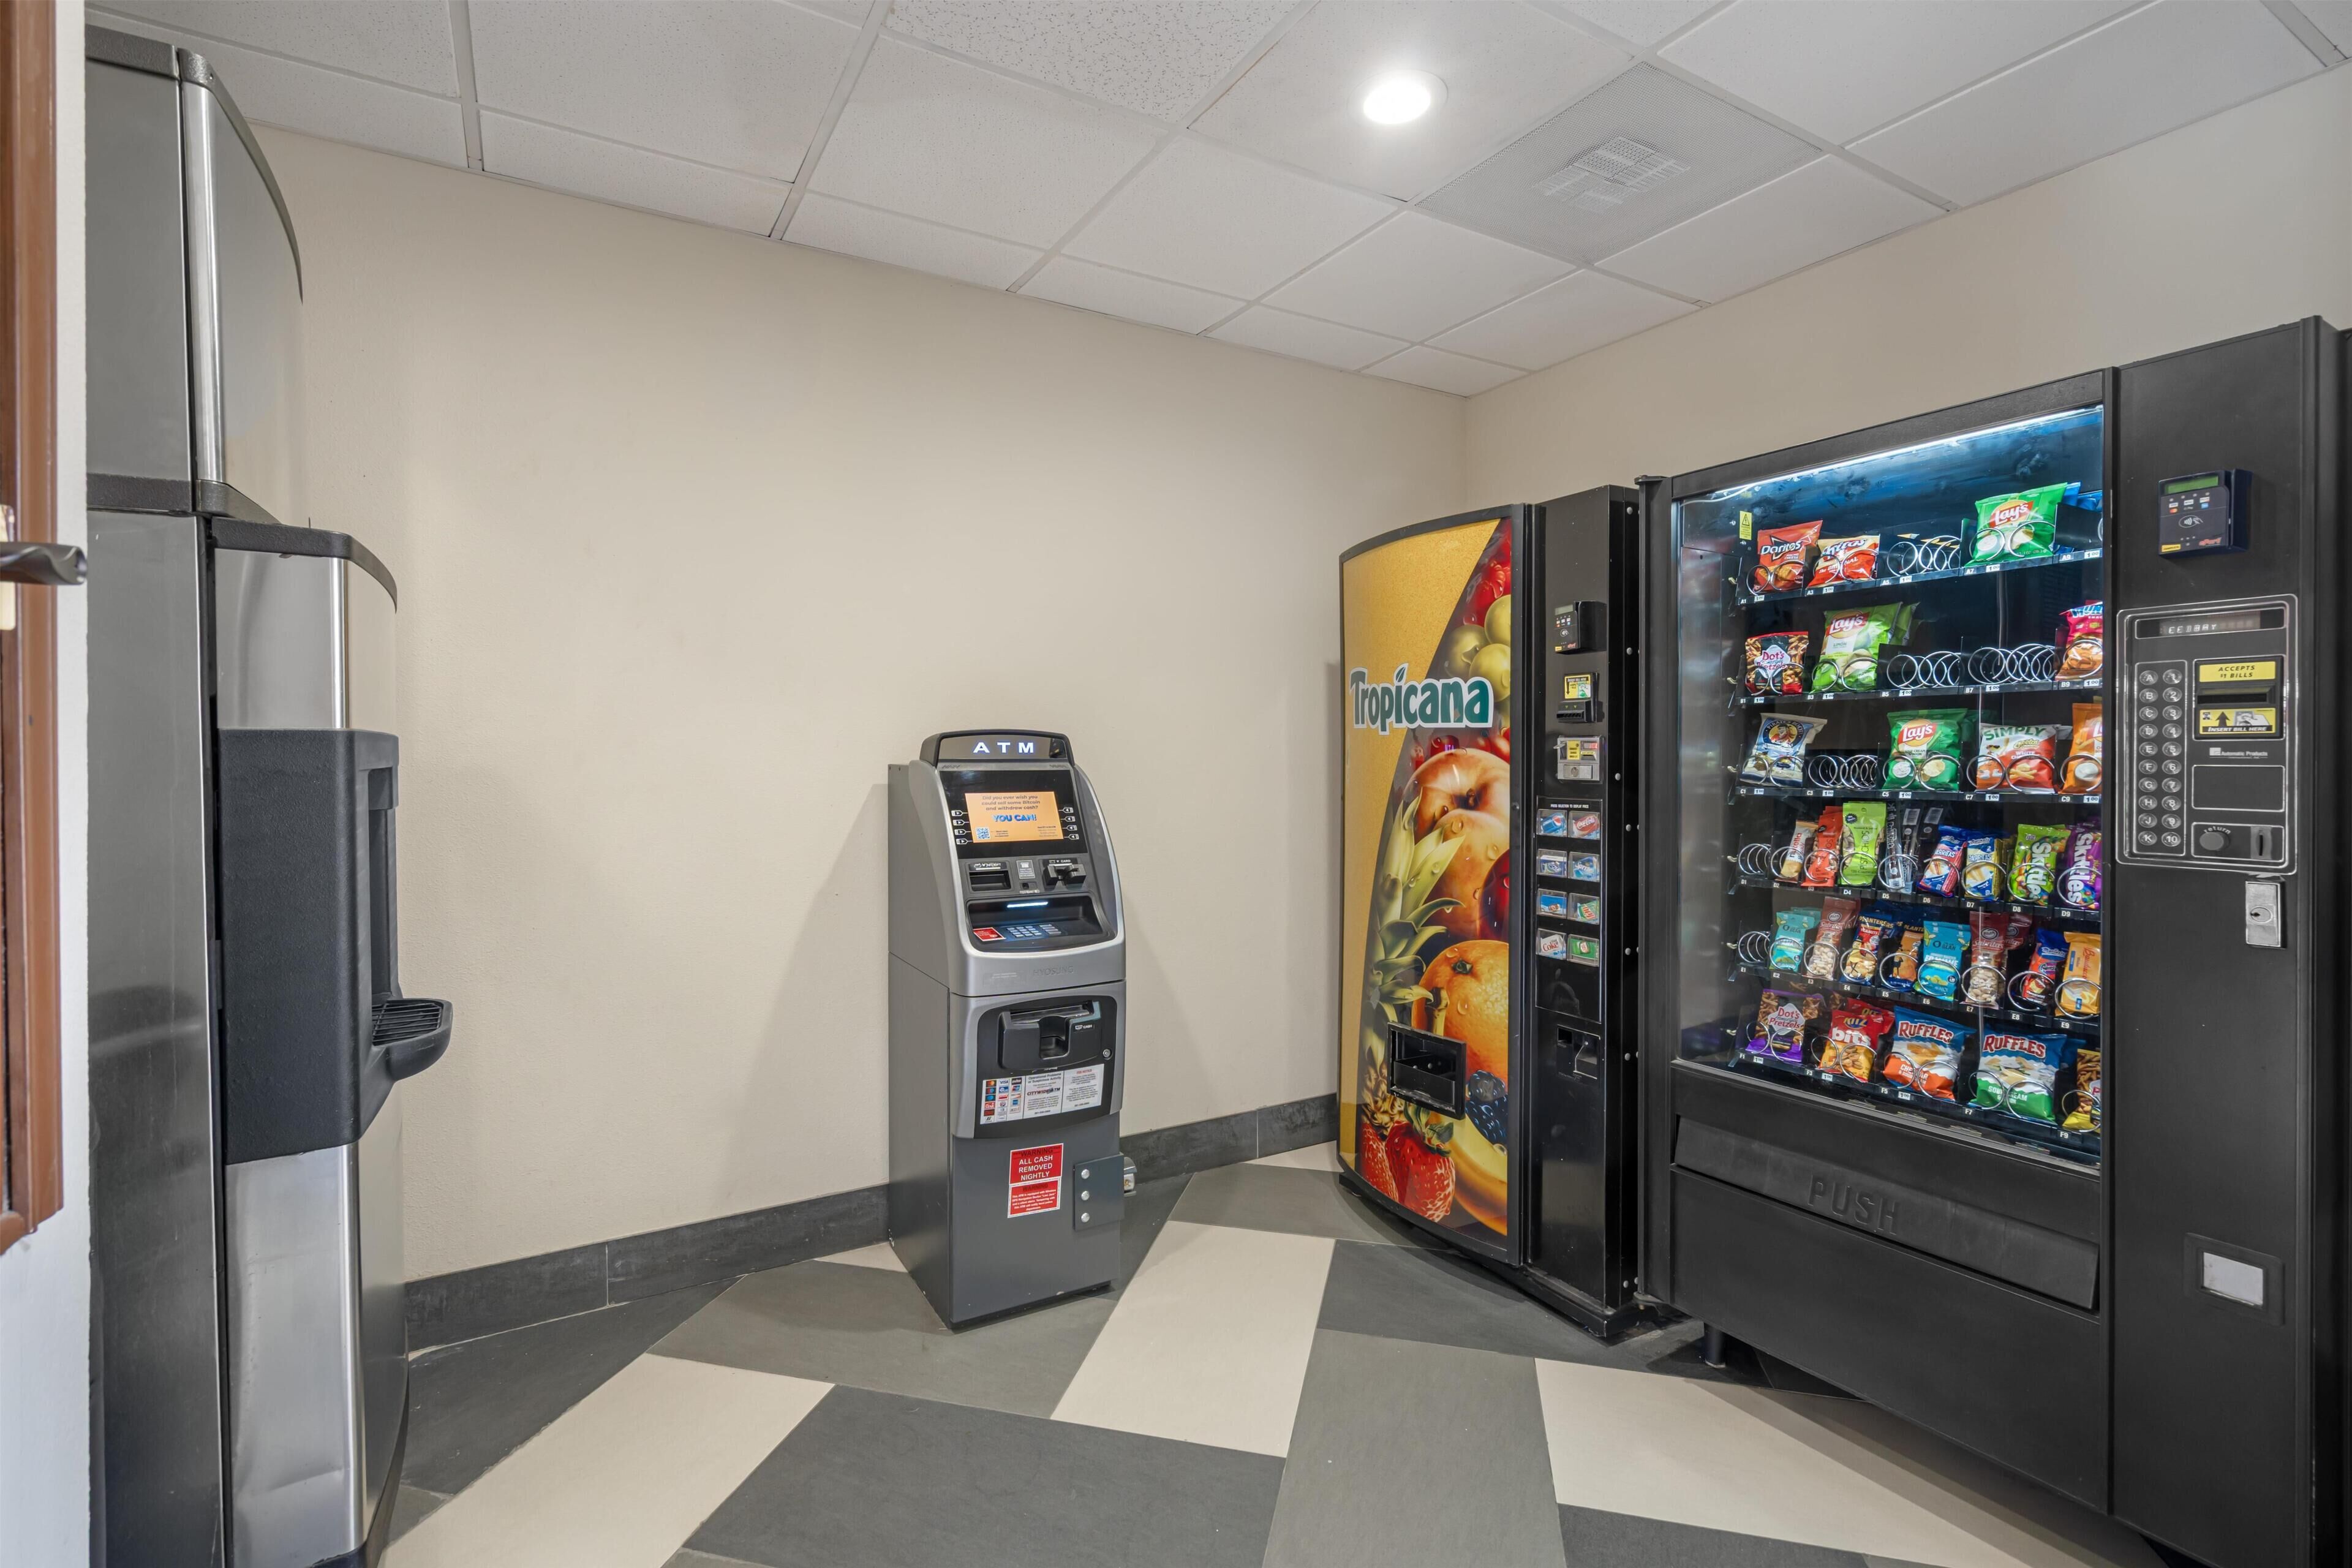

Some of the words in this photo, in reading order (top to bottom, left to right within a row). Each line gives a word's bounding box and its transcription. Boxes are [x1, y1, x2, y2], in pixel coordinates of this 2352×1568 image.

[1993, 502, 2029, 525] Lay's
[1761, 541, 1801, 554] Doritos
[1829, 614, 1863, 635] Lay's
[1762, 651, 1785, 660] Dot's
[1349, 663, 1493, 734] Tropicana
[1902, 724, 1933, 742] Lay's
[1983, 726, 2046, 741] SIMPLY
[973, 742, 1035, 753] ATM
[2203, 826, 2231, 834] return
[1860, 830, 1869, 871] PISTCHIOS
[2067, 832, 2094, 903] Skittles
[1543, 940, 1559, 951] Coke
[1777, 1008, 1800, 1019] Dot's
[1769, 1017, 1800, 1029] Pretzels
[1832, 1027, 1871, 1046] bits
[1898, 1020, 1954, 1044] RUFFLES
[1983, 1034, 2046, 1058] RUFFLES
[2009, 1091, 2027, 1101] REAM
[1019, 1163, 1053, 1173] REMOVED
[1020, 1171, 1050, 1181] NIGHTLY
[1807, 1173, 1897, 1235] PUSH
